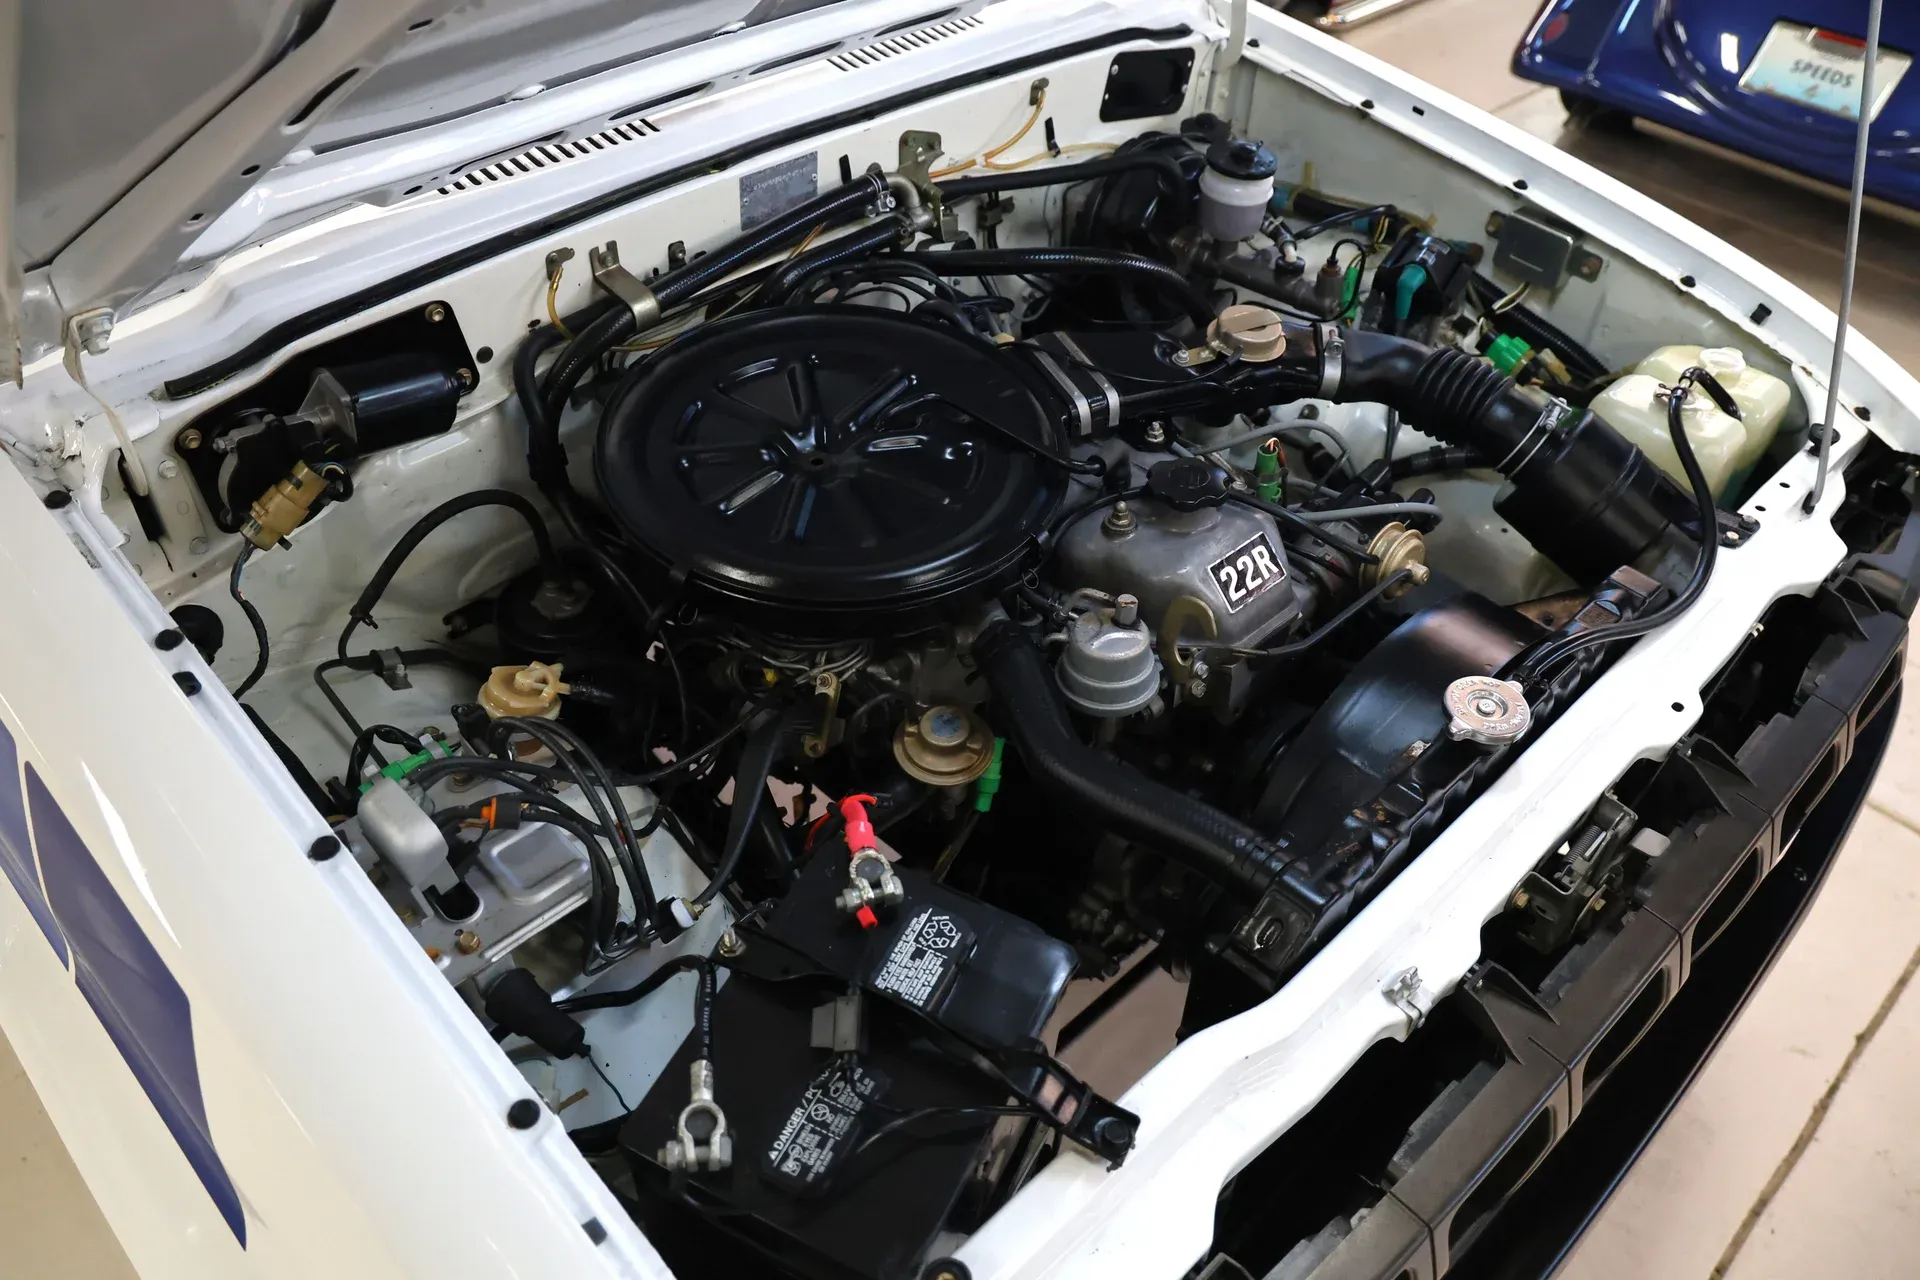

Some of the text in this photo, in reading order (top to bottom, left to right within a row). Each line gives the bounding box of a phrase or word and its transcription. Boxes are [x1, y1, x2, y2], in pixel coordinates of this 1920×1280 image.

[1790, 59, 1857, 88] SPEEDS
[1220, 545, 1279, 601] 22R
[774, 1107, 805, 1150] DANGER
